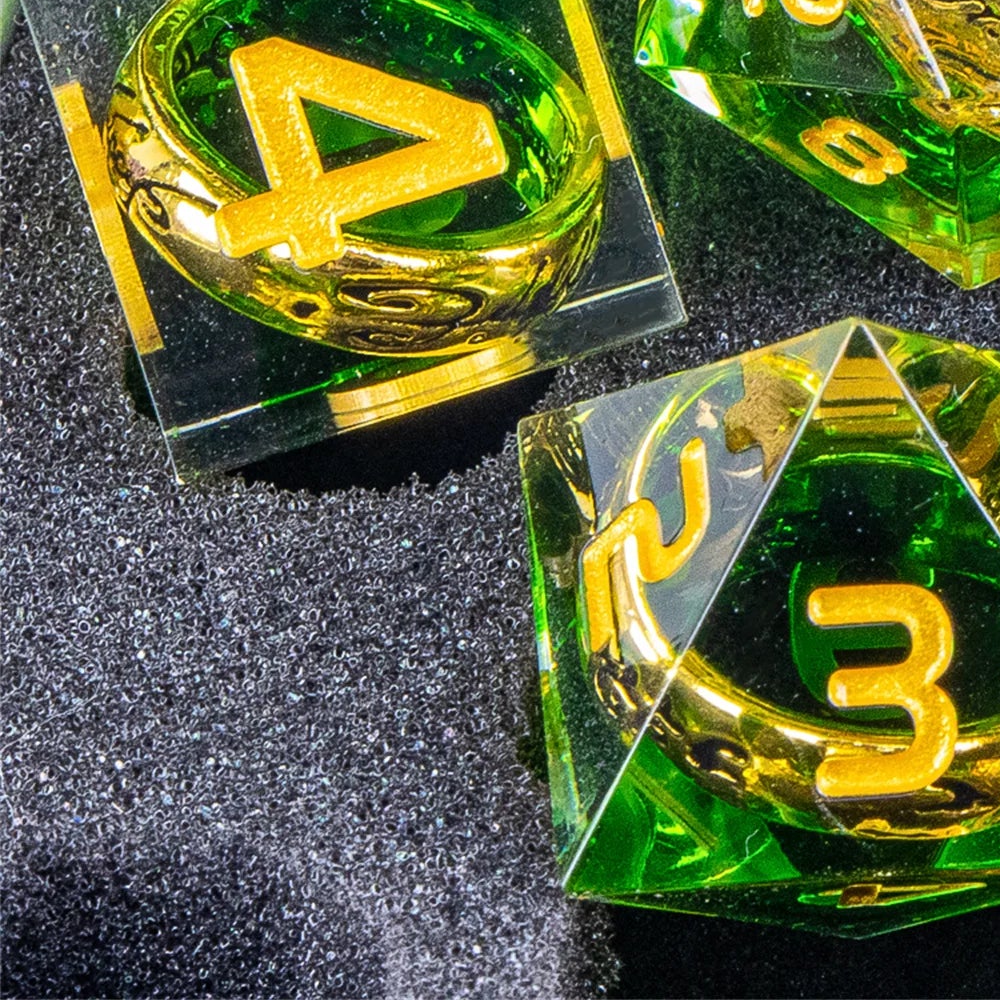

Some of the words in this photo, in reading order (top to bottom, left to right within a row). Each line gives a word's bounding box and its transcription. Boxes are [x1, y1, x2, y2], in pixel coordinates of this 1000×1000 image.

[214, 35, 509, 269] 4
[800, 115, 907, 186] 8
[808, 583, 958, 798] 3
